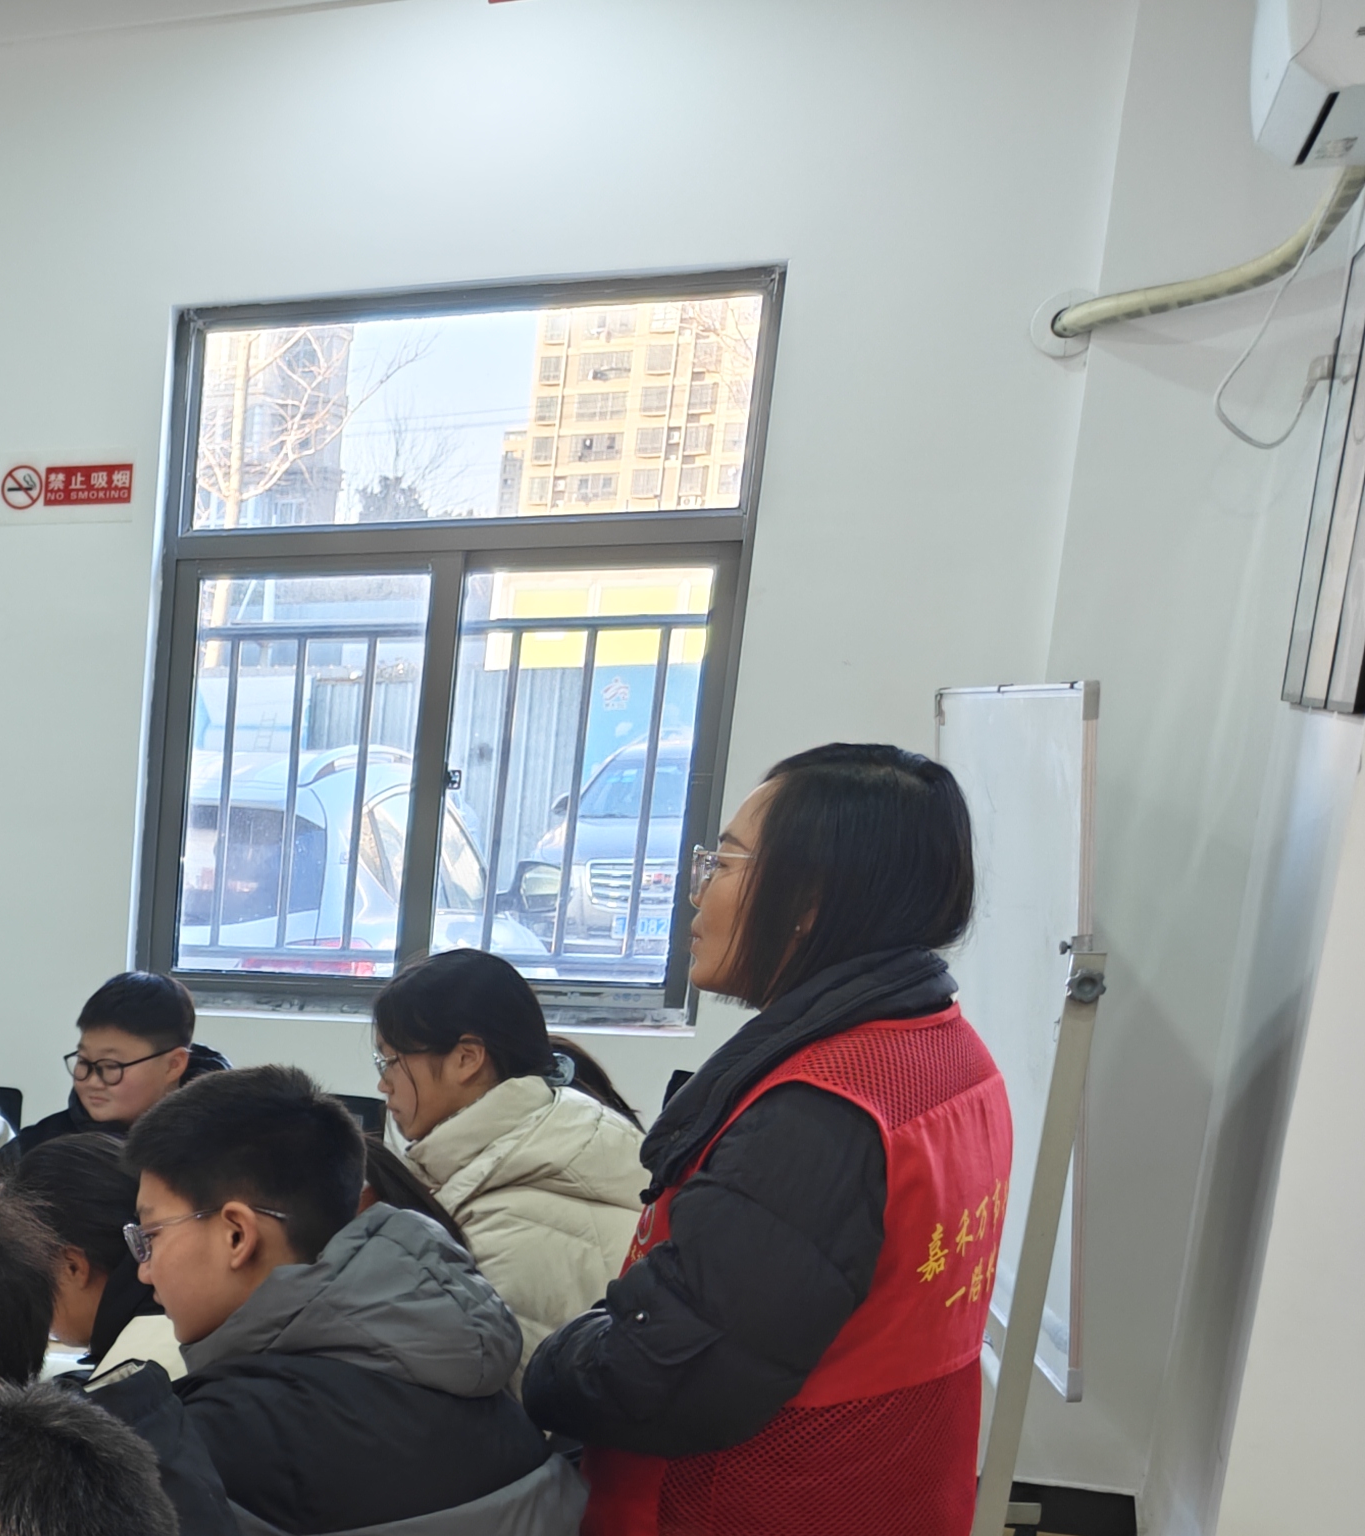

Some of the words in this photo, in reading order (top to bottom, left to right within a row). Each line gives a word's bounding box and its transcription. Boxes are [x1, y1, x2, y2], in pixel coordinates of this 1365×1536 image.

[48, 470, 131, 490] 禁止吸烟
[46, 492, 64, 501] NO
[70, 489, 129, 500] SMOKING
